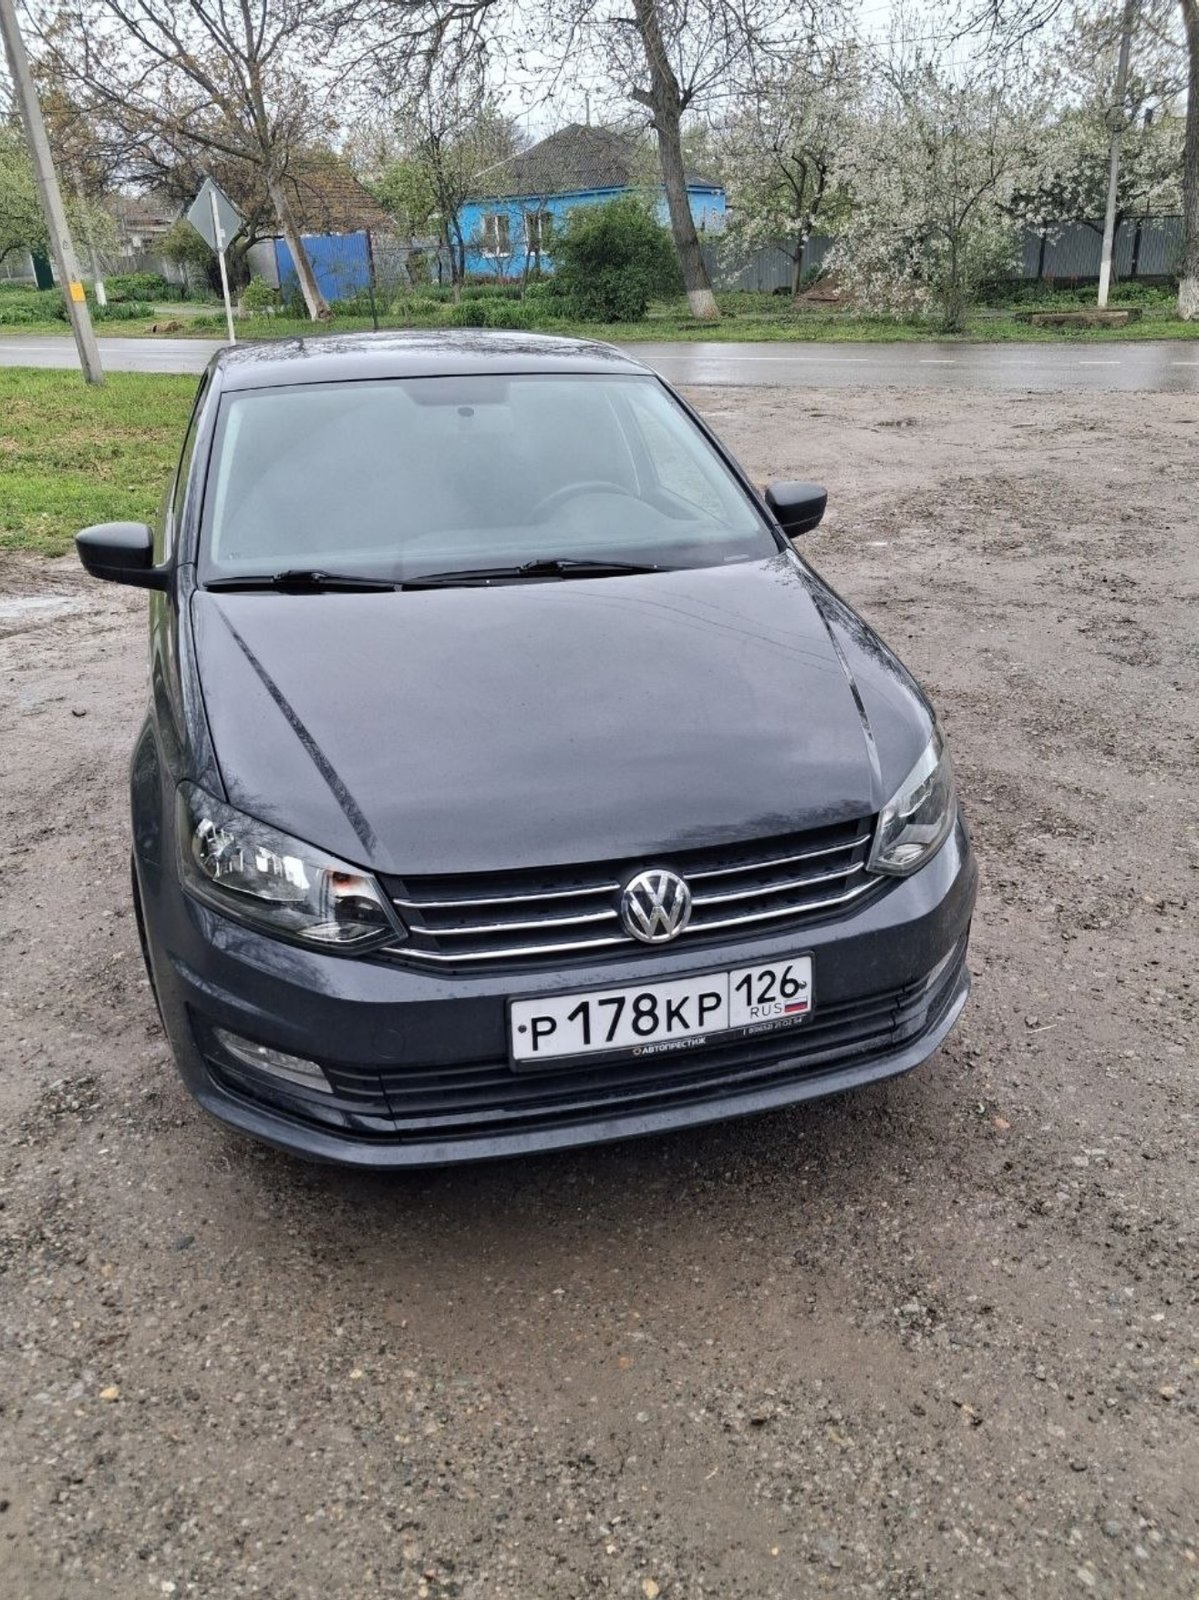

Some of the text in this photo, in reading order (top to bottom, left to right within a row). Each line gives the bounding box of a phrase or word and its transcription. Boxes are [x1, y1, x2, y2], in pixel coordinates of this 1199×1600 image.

[735, 966, 799, 1006] 126
[750, 1003, 782, 1018] RUS
[642, 1036, 706, 1053] АВТОПРЕСТИЖ
